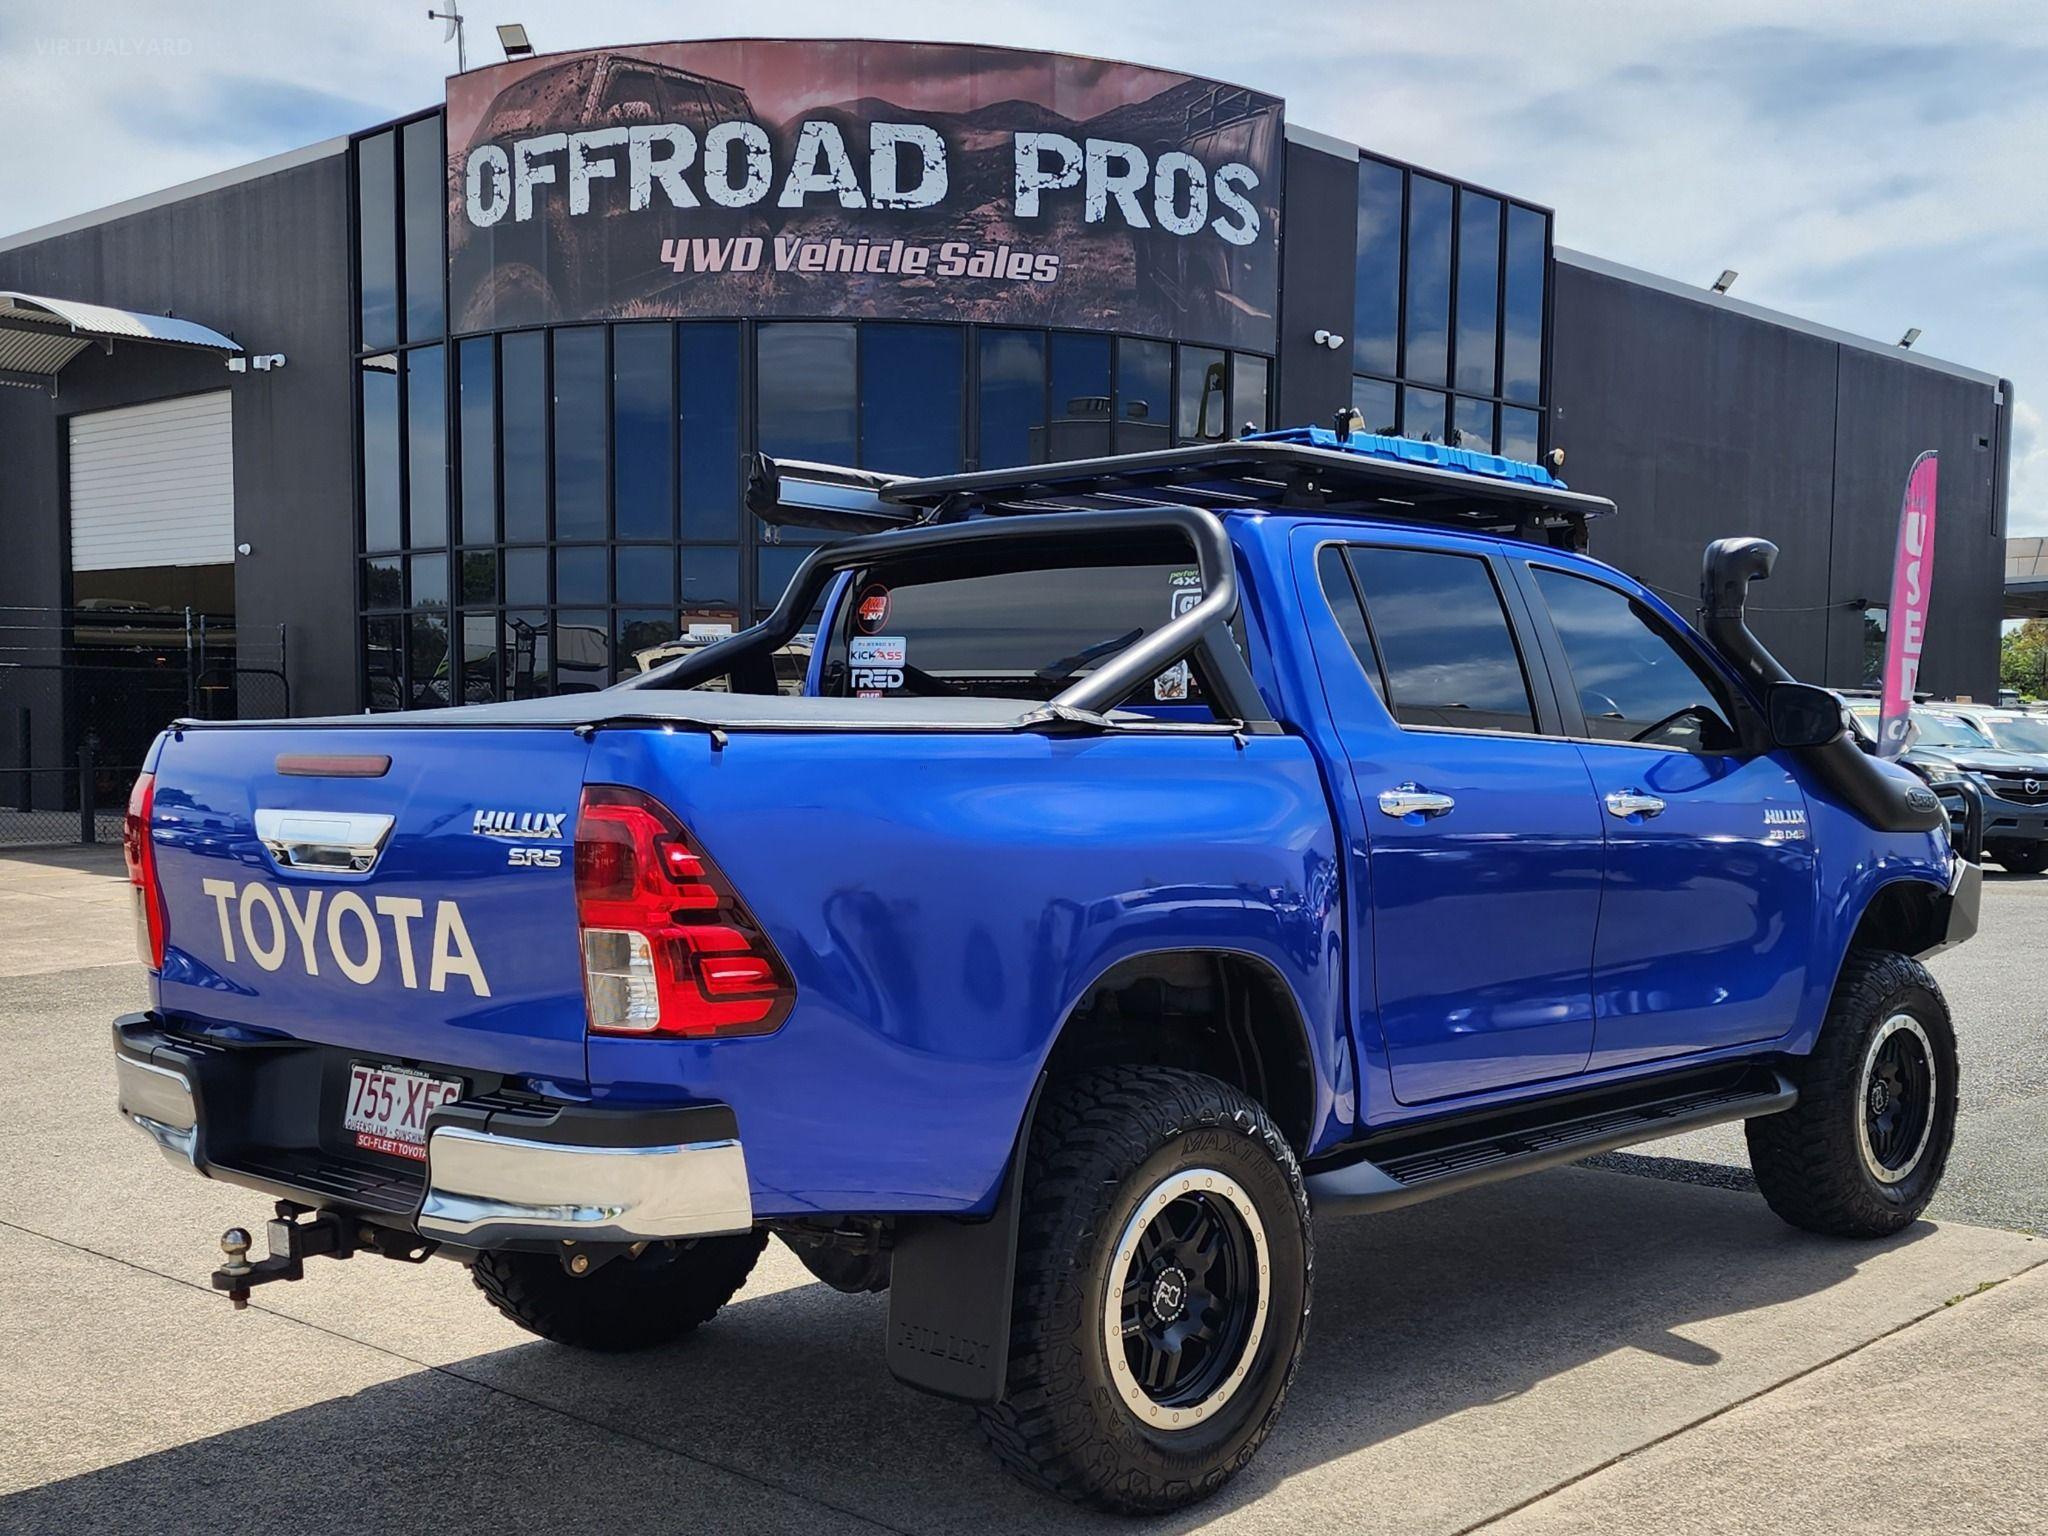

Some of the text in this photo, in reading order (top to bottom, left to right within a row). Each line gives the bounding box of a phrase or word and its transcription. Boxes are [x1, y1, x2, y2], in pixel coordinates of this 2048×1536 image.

[465, 121, 1261, 246] OFFROAD PROS
[660, 236, 1060, 283] 4WD Vehicle Sales
[851, 668, 905, 689] TRED
[472, 809, 567, 840] HILUX
[1763, 808, 1807, 825] HILUX
[202, 878, 491, 998] TOYOTA
[352, 1070, 397, 1123] 755
[357, 1134, 397, 1153] SCI-FLEET
